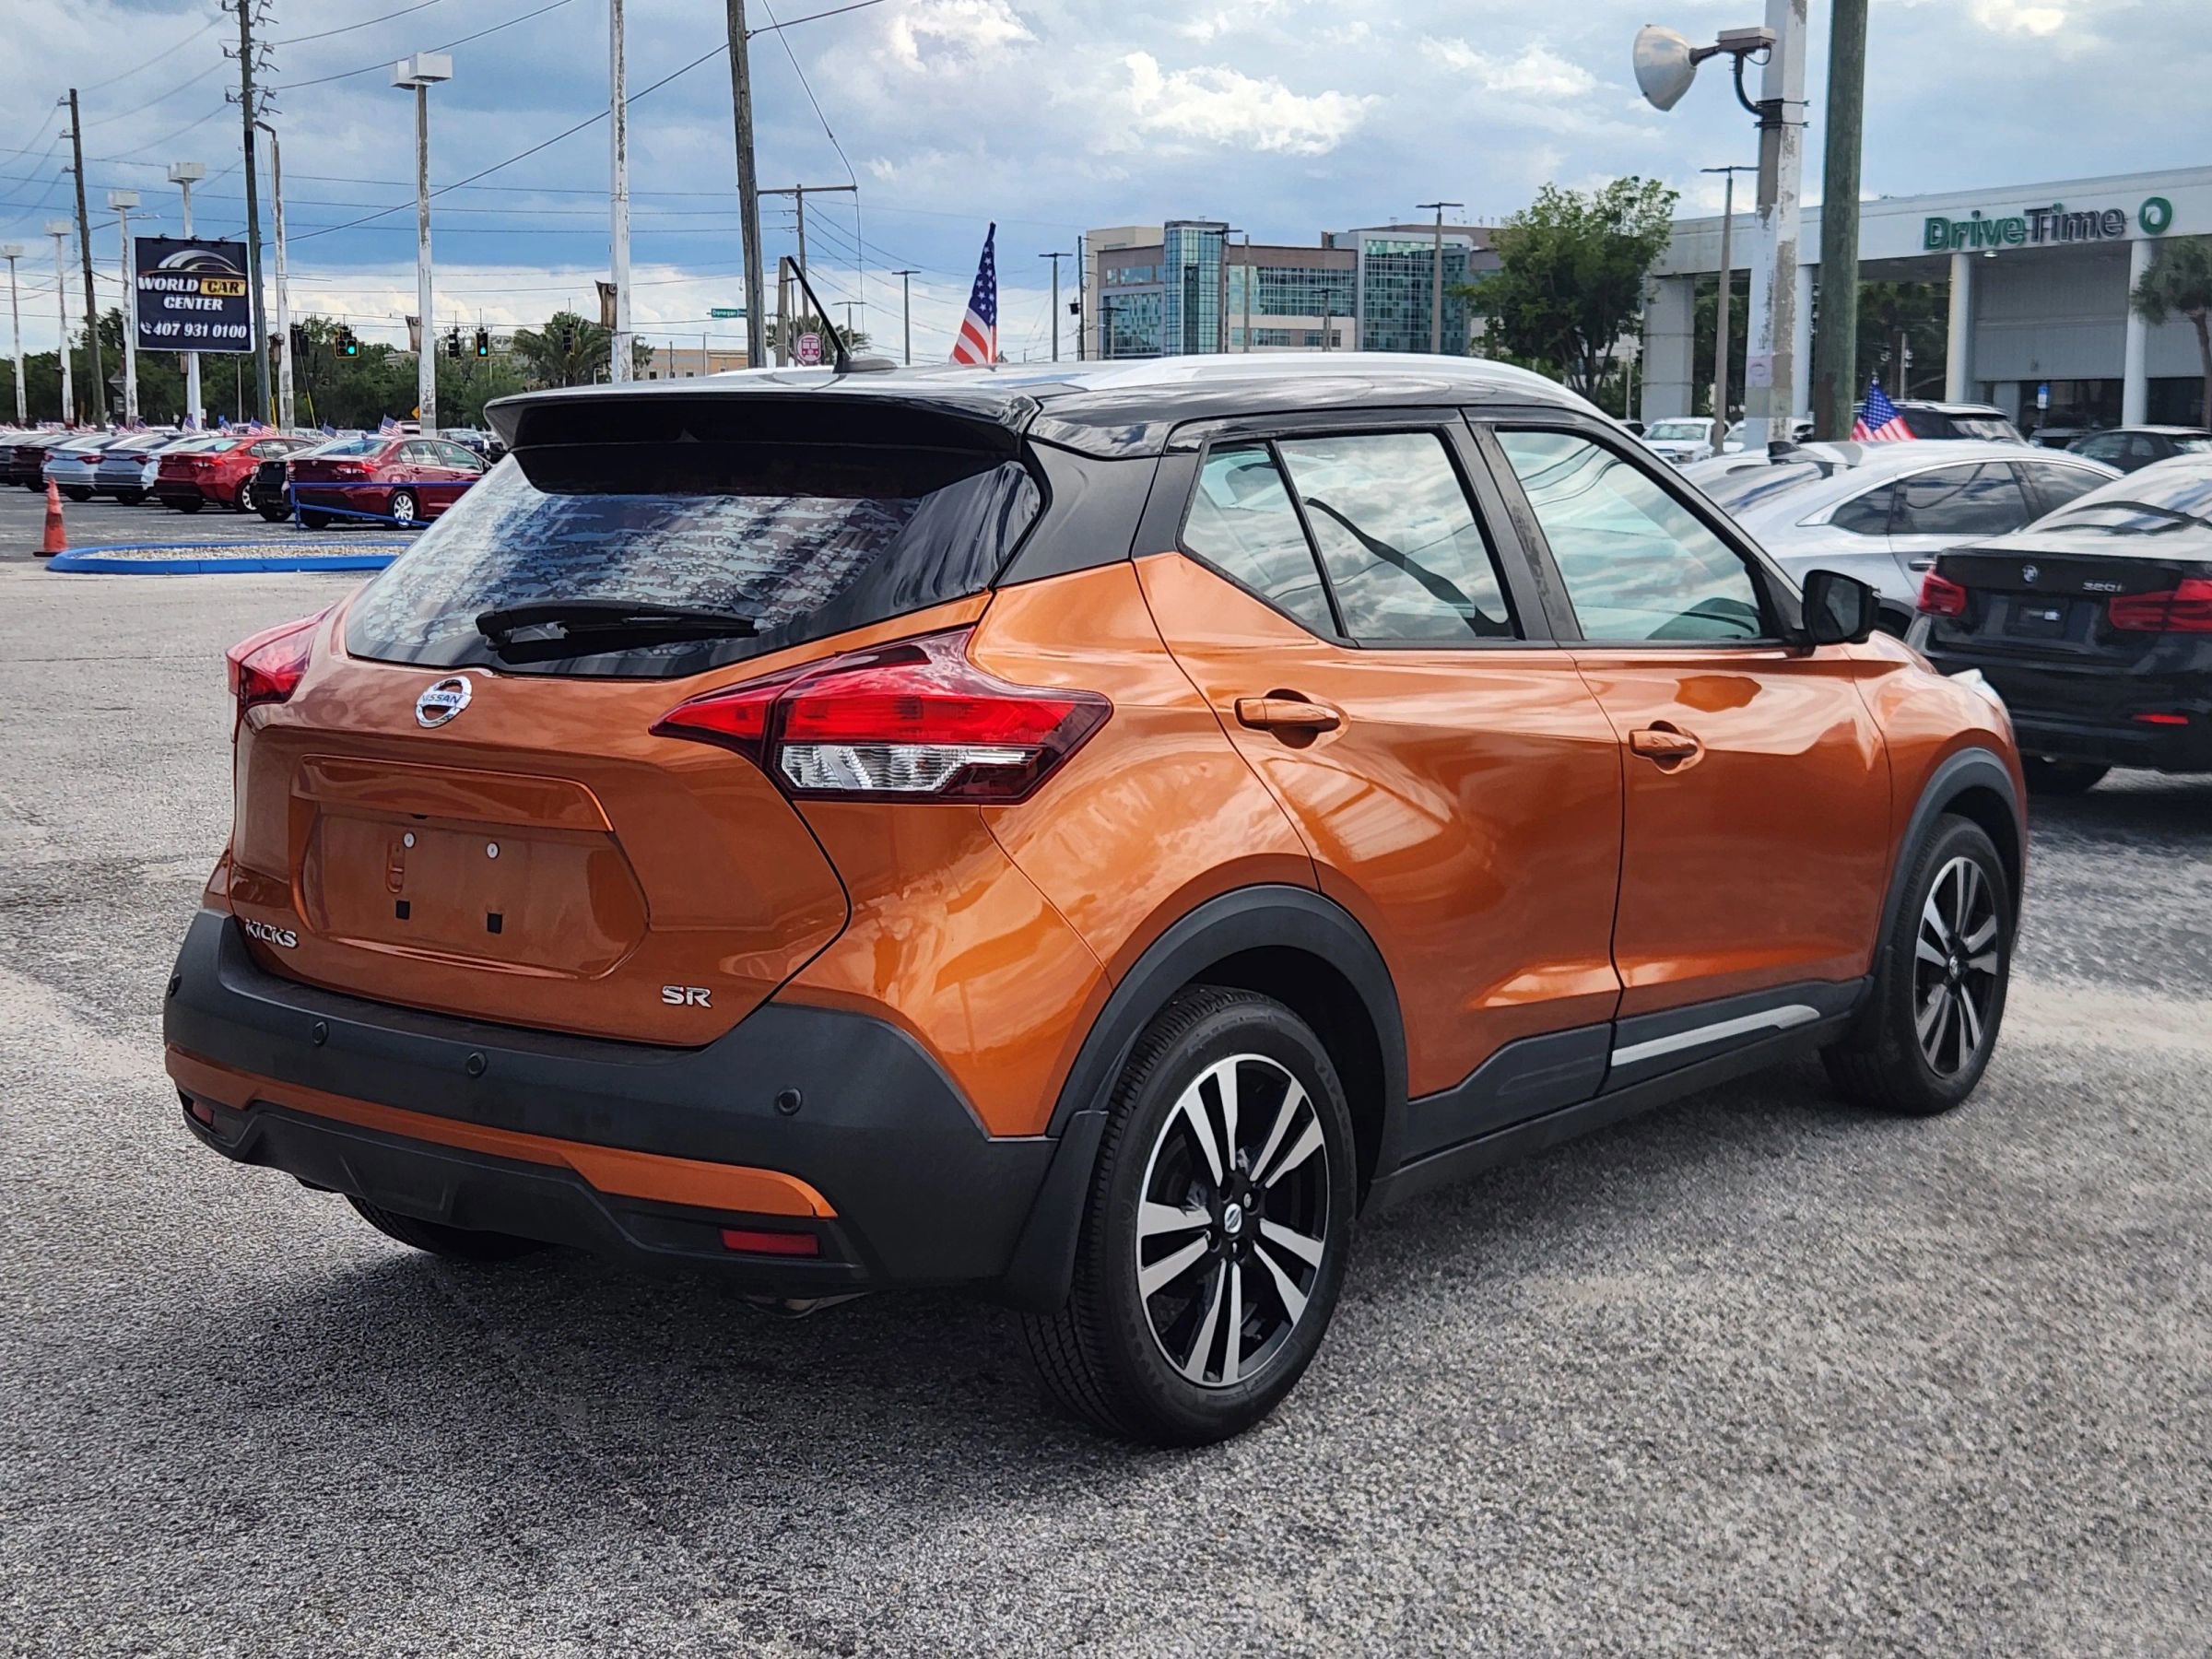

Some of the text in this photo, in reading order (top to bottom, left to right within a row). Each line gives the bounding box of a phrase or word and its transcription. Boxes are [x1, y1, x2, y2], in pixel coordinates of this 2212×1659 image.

[1923, 202, 2126, 252] DriveTime
[137, 276, 240, 294] WORLD CAR
[163, 295, 223, 311] CENTER
[152, 323, 247, 338] 407 931 0100
[422, 693, 463, 703] NISSAN
[244, 917, 298, 948] KICKS
[661, 984, 712, 1008] SR
